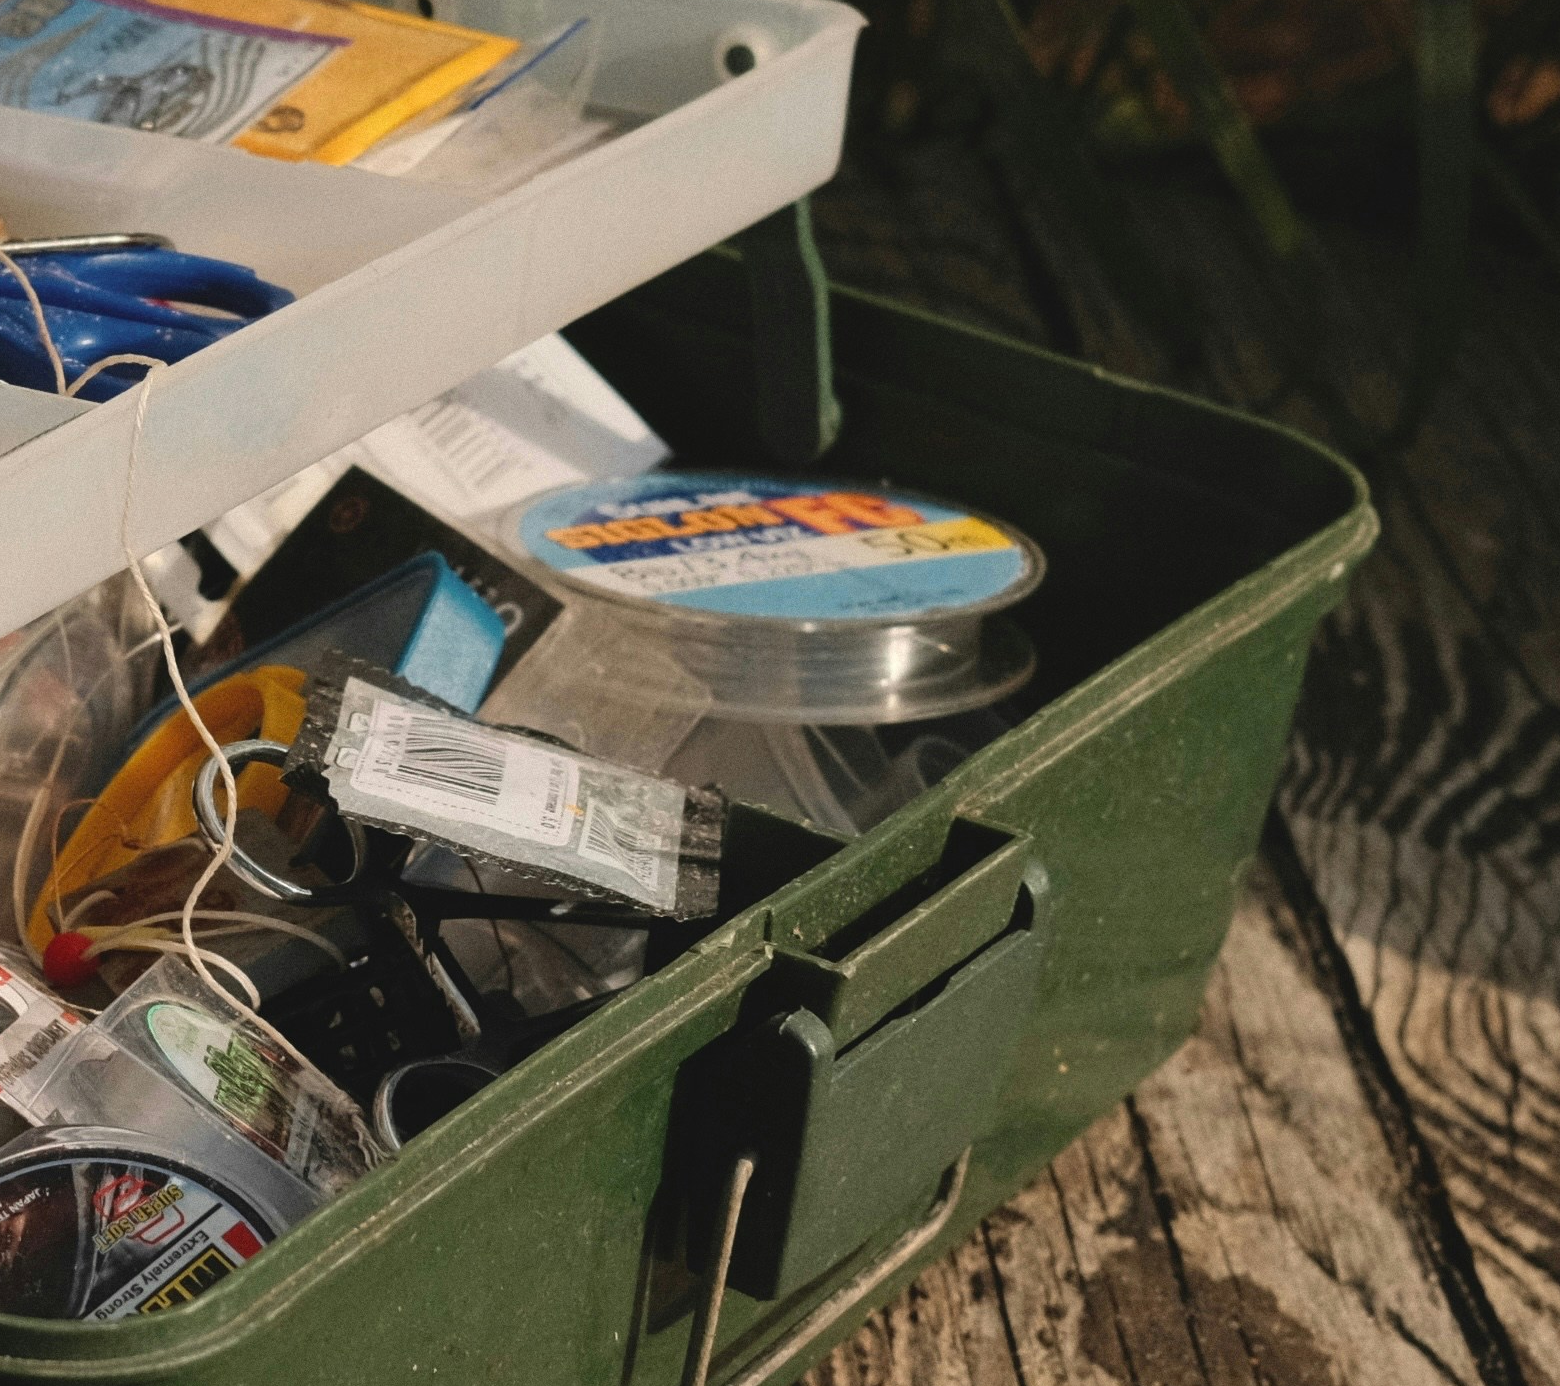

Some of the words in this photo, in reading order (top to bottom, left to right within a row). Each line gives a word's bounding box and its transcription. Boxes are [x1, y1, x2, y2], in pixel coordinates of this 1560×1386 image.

[8, 1187, 41, 1214] JAPAN
[134, 1184, 183, 1229] SUPER
[93, 1215, 134, 1252] SOFT
[141, 1230, 209, 1289] Extremely
[96, 1277, 144, 1321] Strong
